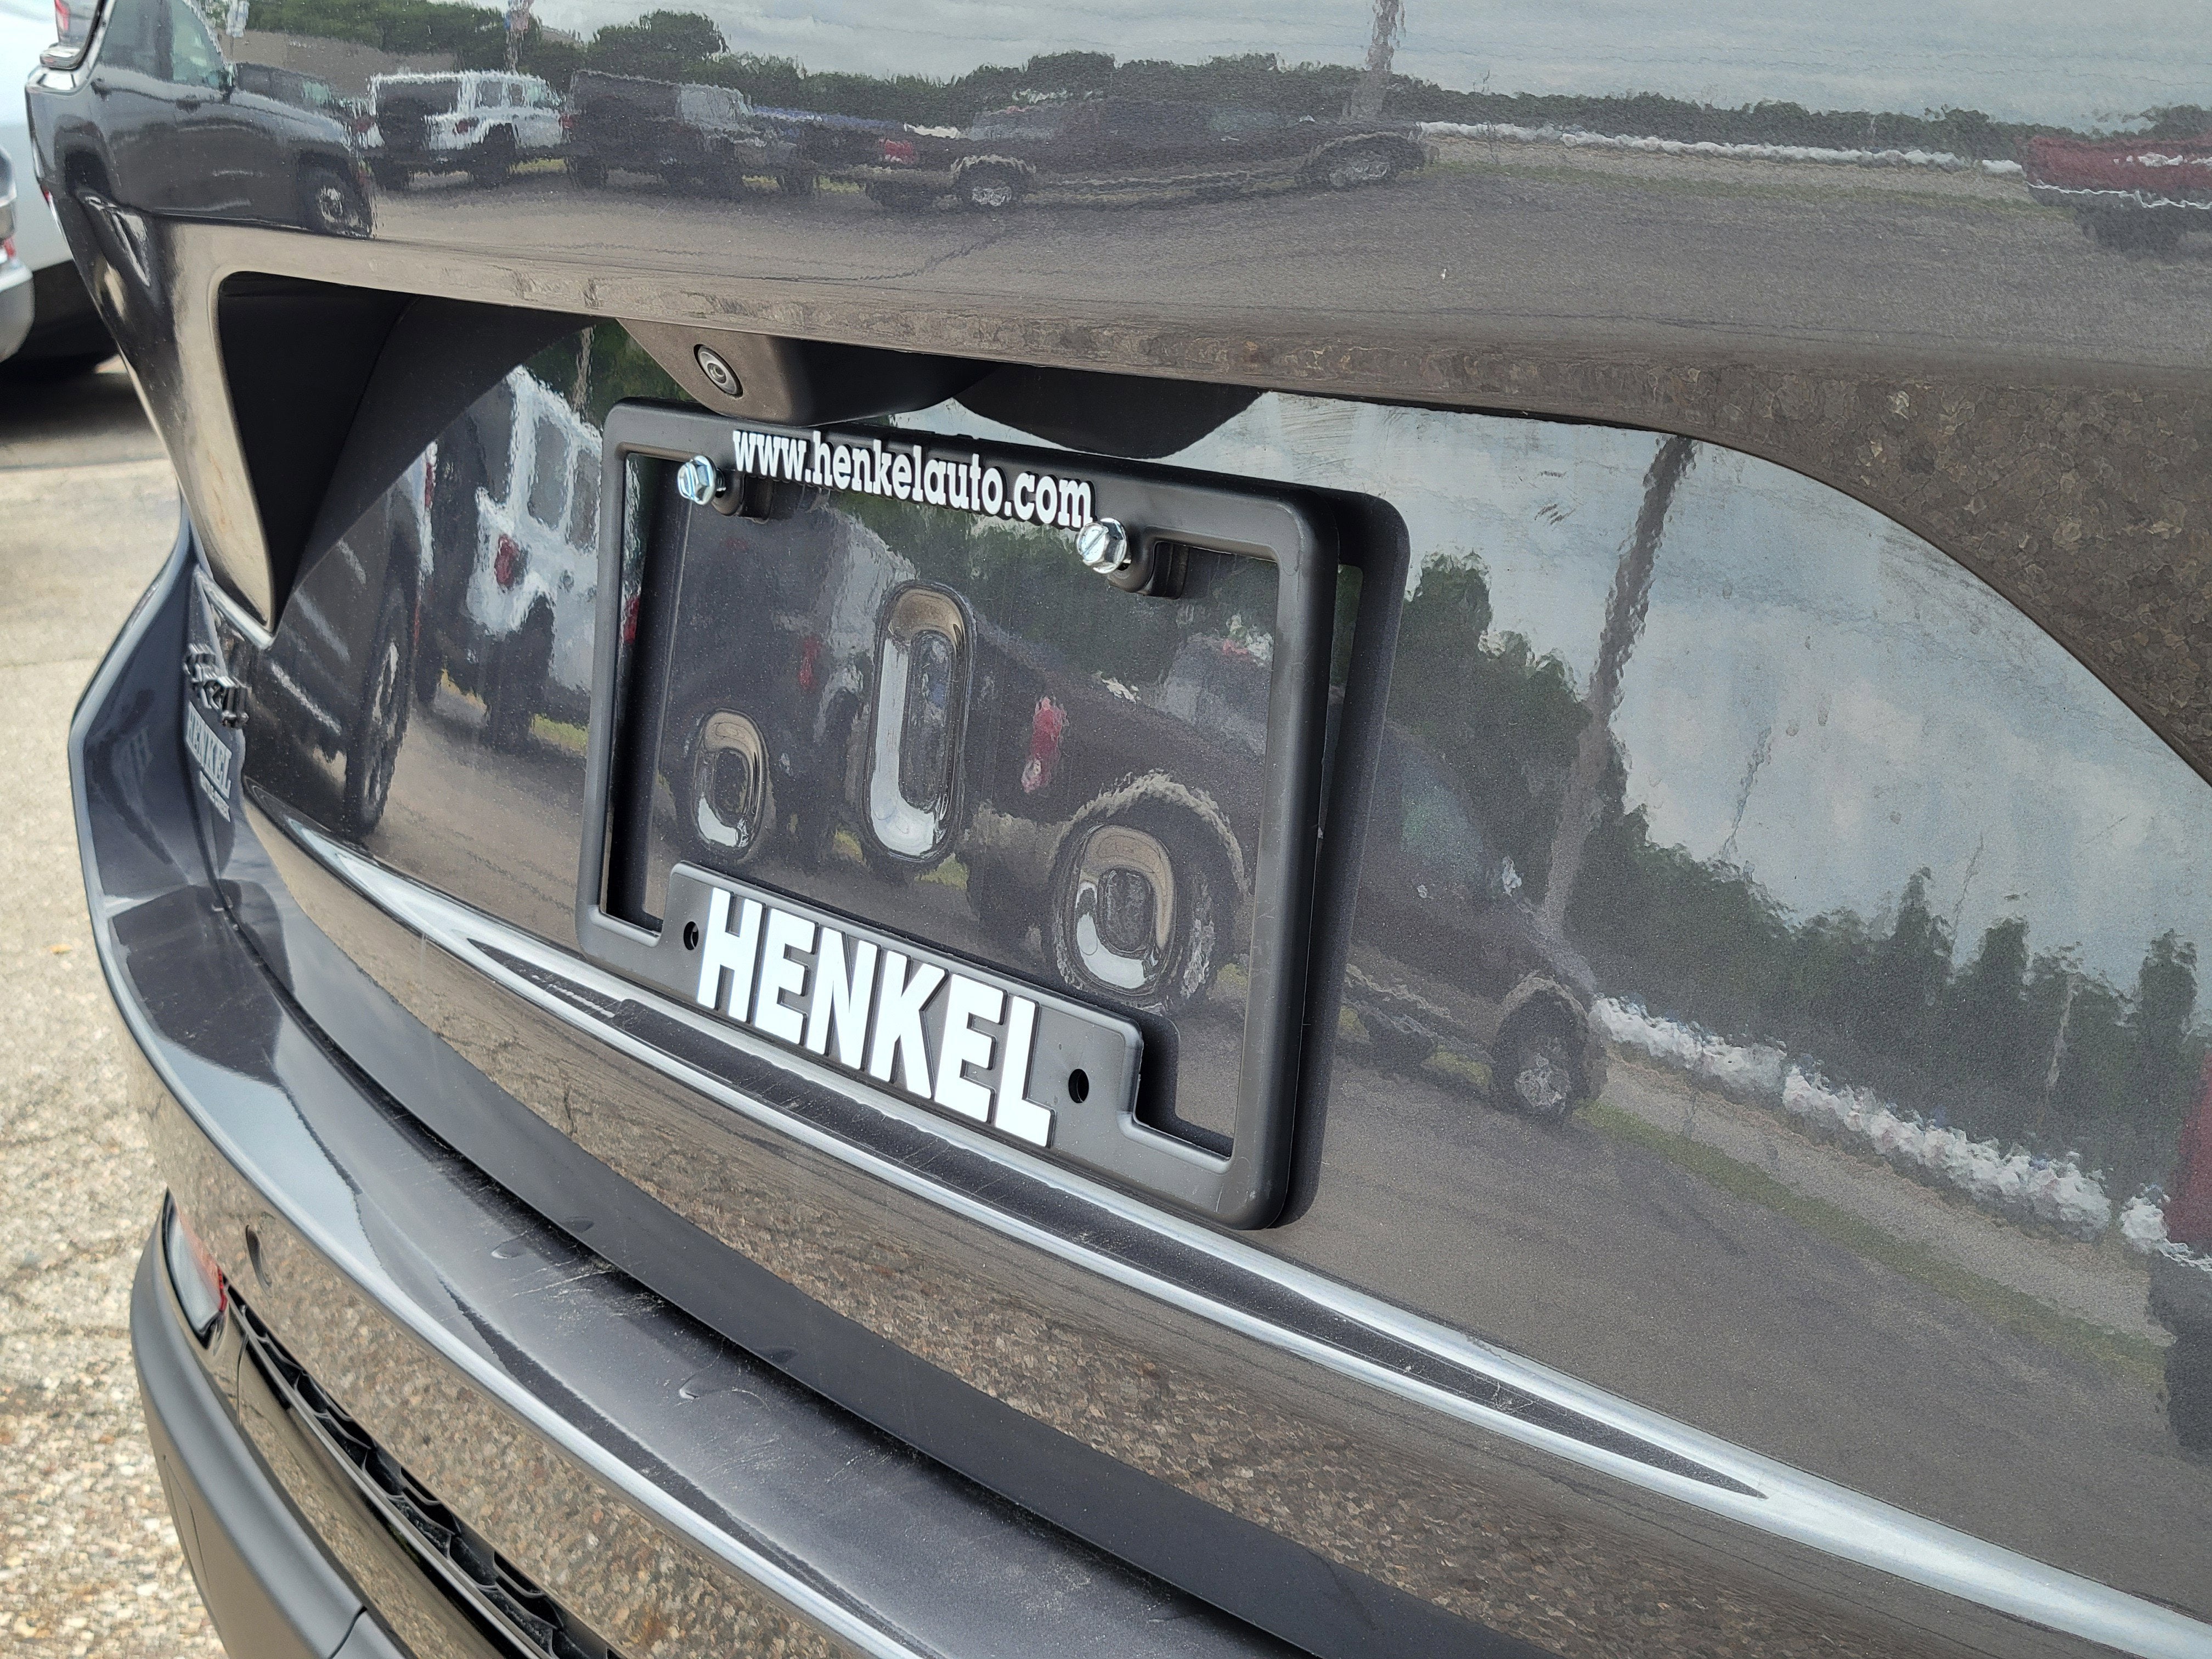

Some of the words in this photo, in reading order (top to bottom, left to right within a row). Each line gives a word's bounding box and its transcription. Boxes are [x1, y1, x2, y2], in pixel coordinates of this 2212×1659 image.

[732, 430, 1093, 529] www.henkelauto.com
[186, 701, 233, 799] HENKEL
[697, 887, 1052, 1147] HENKEL
